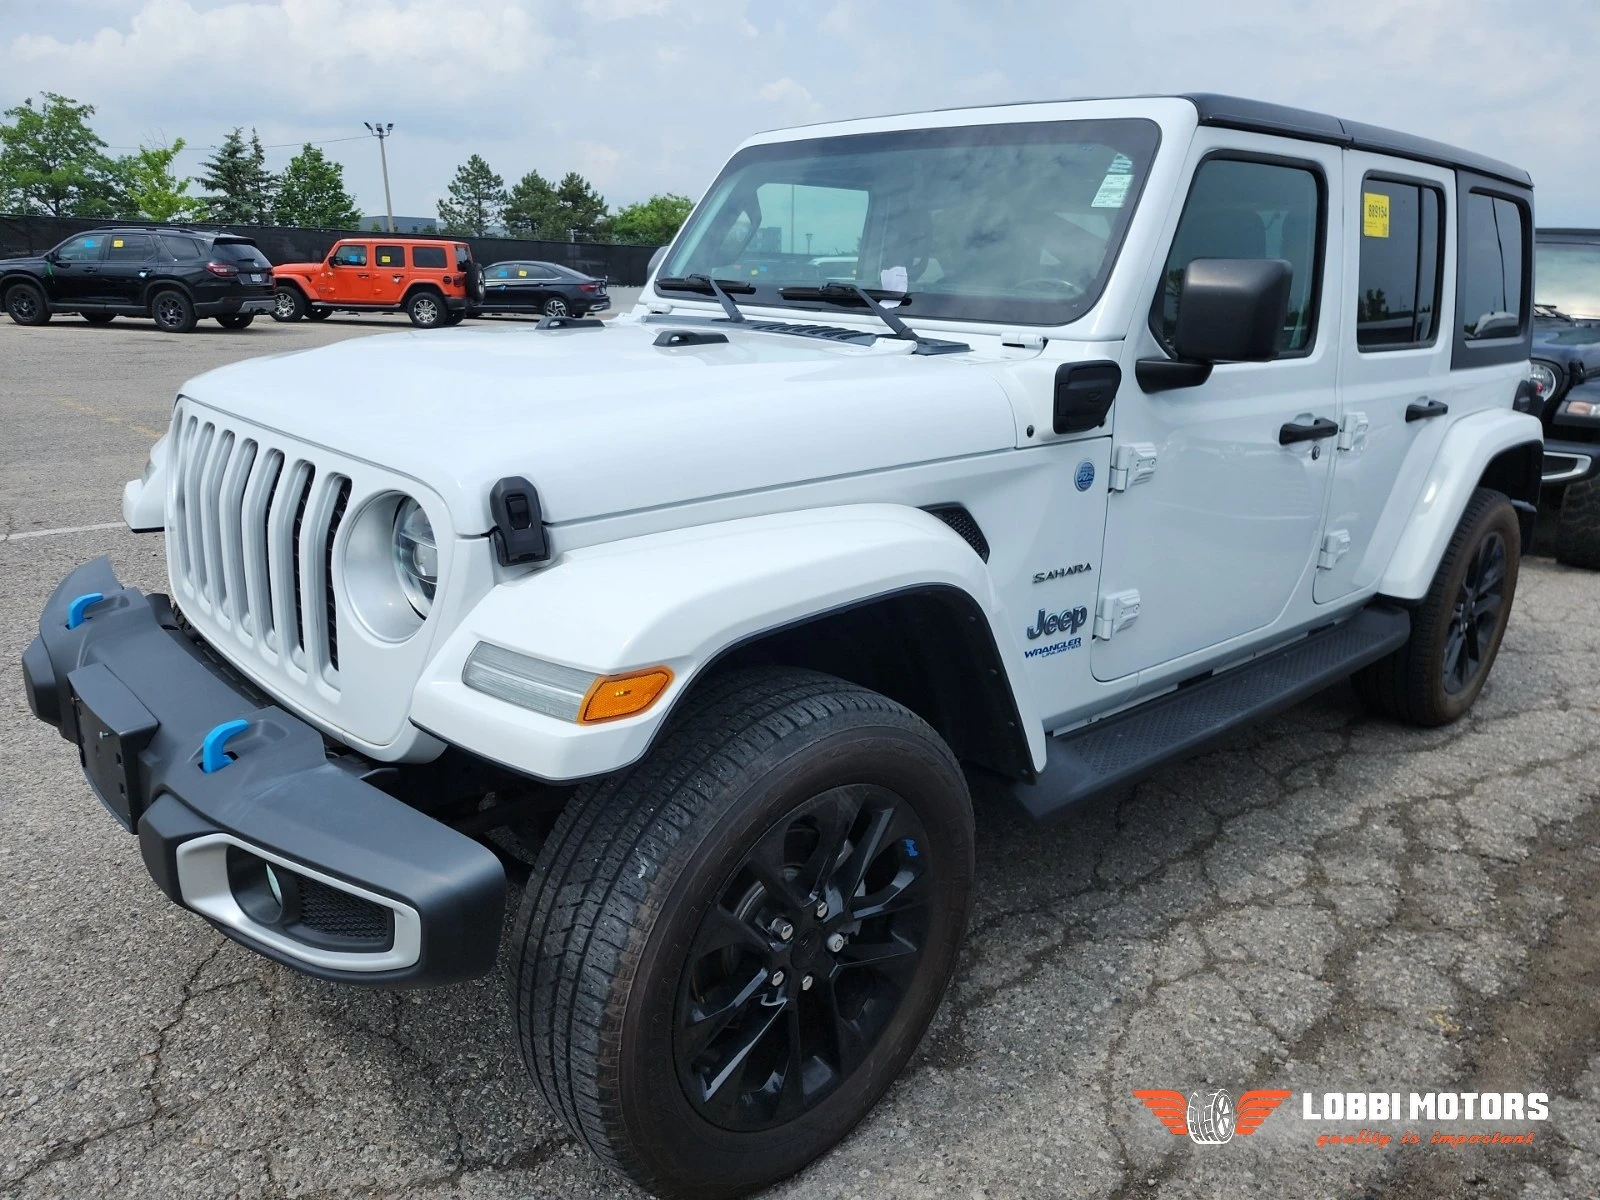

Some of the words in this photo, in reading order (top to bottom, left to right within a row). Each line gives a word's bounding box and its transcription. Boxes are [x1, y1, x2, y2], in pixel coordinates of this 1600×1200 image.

[1033, 563, 1092, 583] SAHARA
[1027, 605, 1087, 639] Jeep
[1024, 637, 1082, 658] WRANGLER
